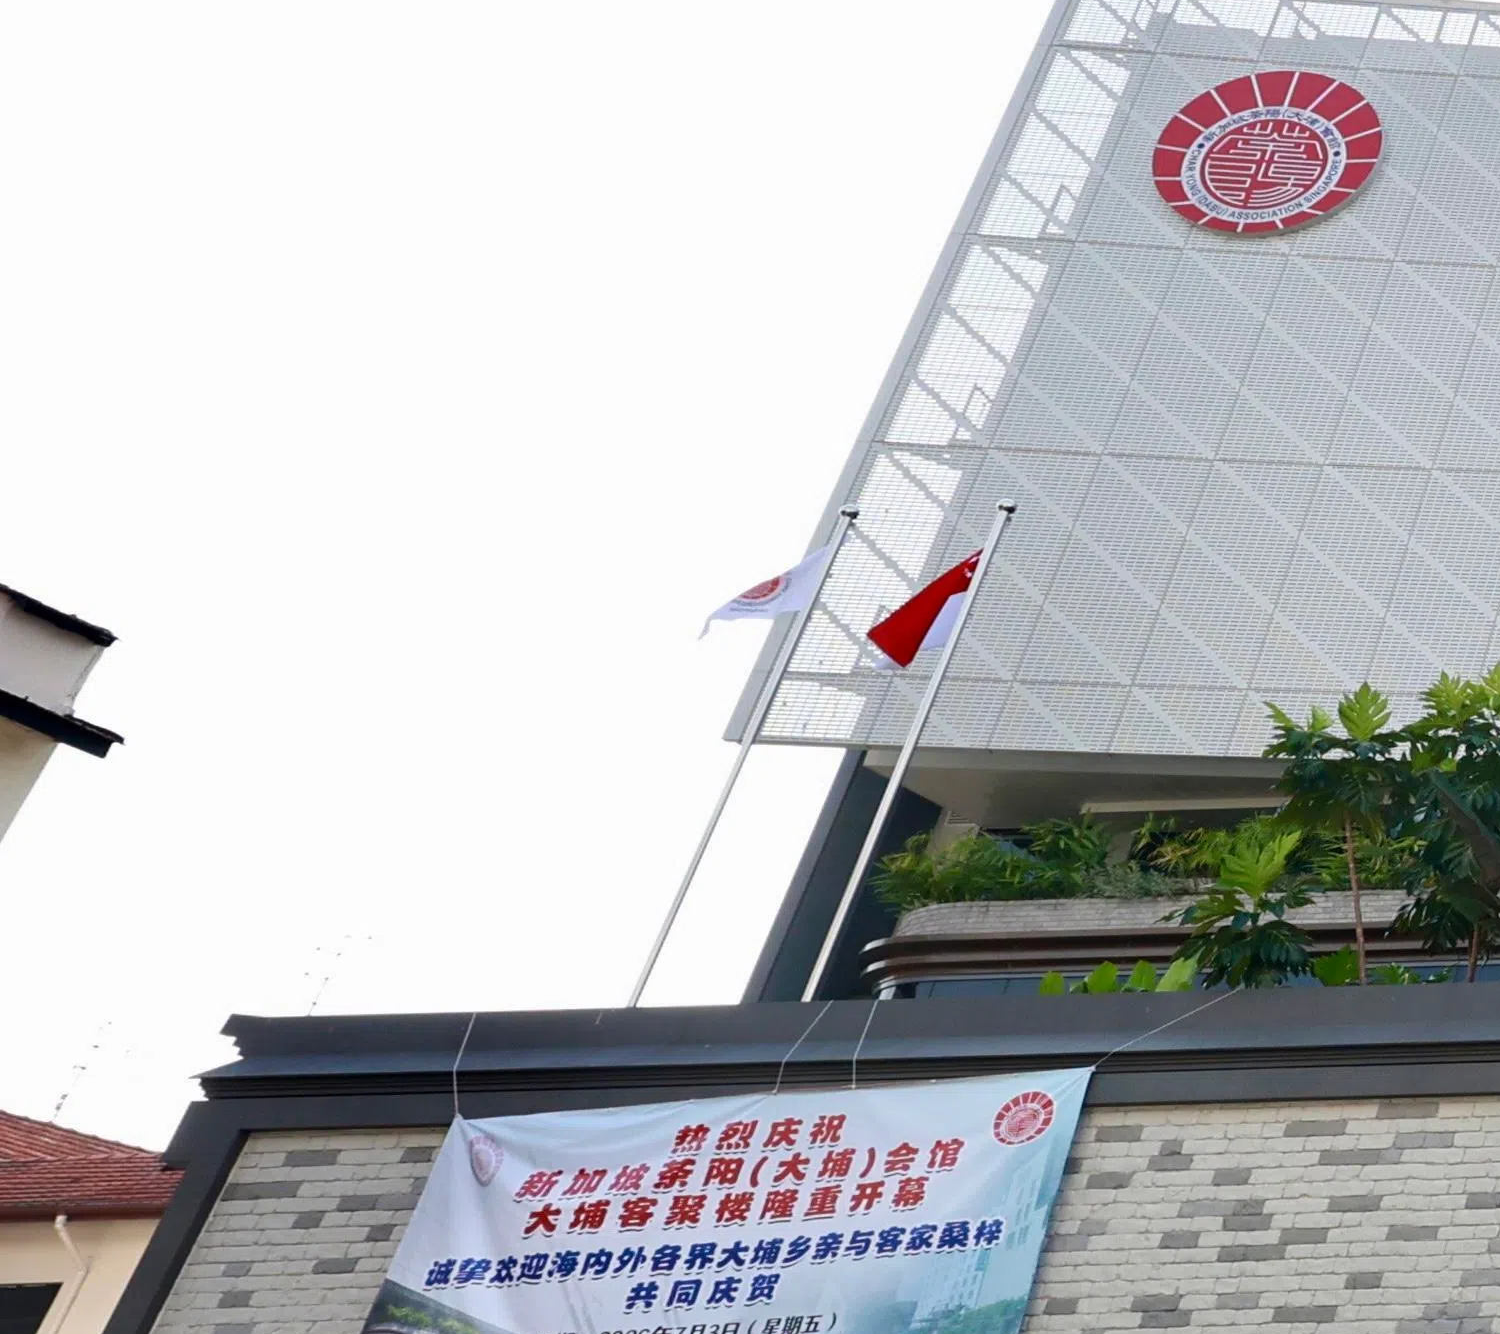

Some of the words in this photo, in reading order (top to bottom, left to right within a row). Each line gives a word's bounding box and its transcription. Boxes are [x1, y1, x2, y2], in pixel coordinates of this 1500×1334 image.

[1185, 149, 1201, 173] CHAR
[1303, 158, 1343, 204] SINGAPORE
[1185, 173, 1202, 198] YONG
[1196, 193, 1229, 217] (DABU)
[1229, 202, 1304, 221] ASSOCIATION
[671, 1114, 847, 1155] 热烈庆祝
[522, 1176, 930, 1238] 大埔客聚楼隆重开幕
[422, 1218, 1005, 1292] 诚挚欢迎海内外各界大埔乡亲与客家桑梓
[624, 1273, 782, 1315] 共同庆贺
